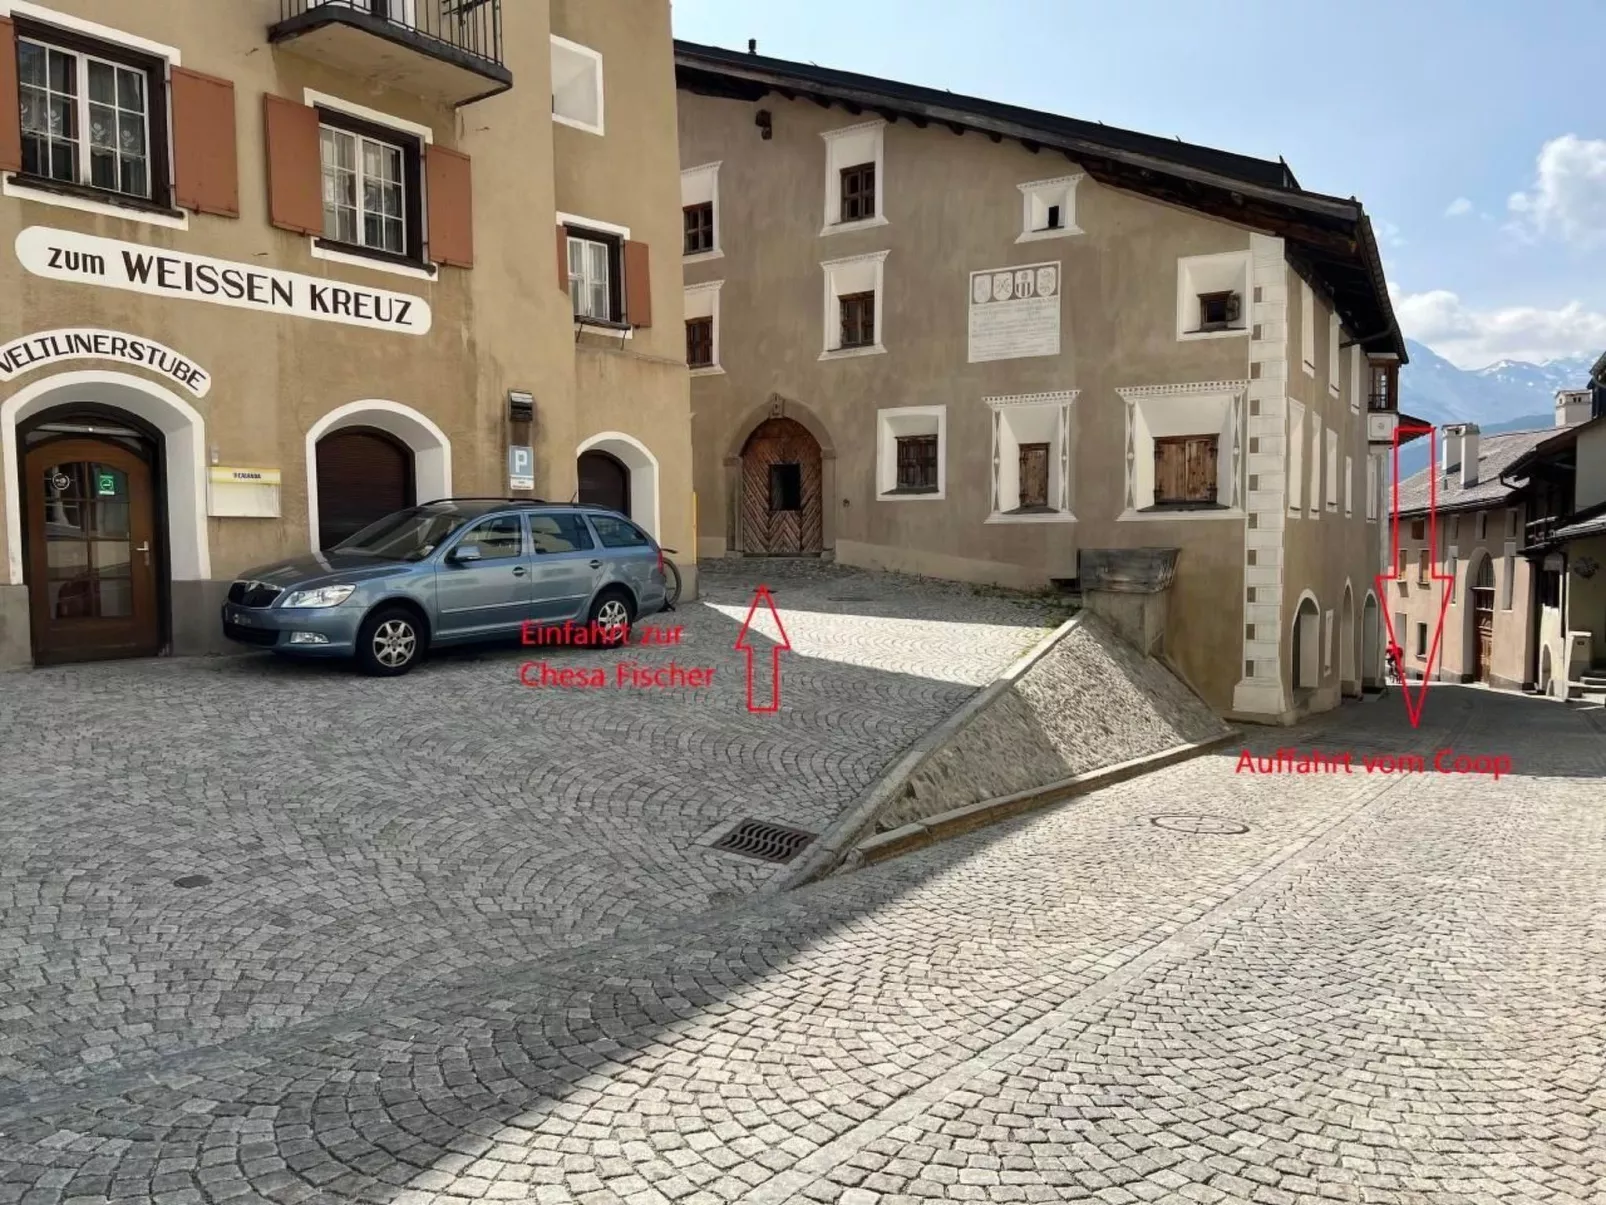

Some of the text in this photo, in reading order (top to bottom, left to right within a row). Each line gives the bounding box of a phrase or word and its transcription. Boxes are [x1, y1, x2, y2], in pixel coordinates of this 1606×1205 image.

[47, 246, 413, 326] zum WEISSEN KREUZ
[0, 333, 206, 391] VELTLINERSTUBE
[515, 450, 528, 473] P
